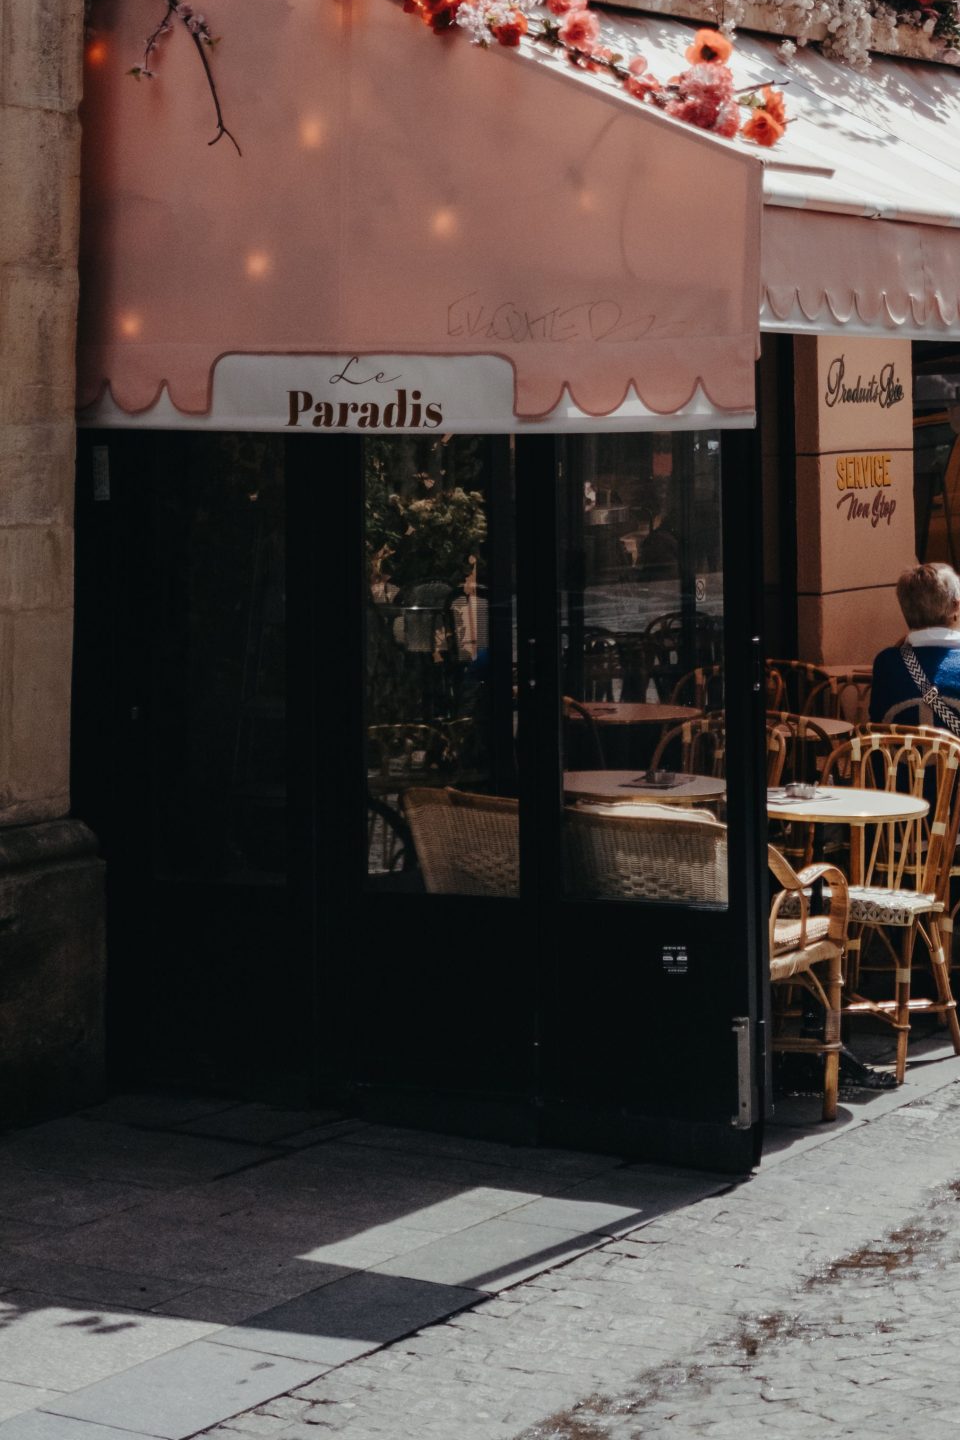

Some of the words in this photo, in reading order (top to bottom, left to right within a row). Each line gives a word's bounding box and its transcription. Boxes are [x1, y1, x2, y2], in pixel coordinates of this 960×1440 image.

[329, 356, 402, 385] Le
[825, 354, 880, 407] Produits
[878, 363, 904, 408] Bio
[284, 389, 443, 428] Paradis
[836, 454, 892, 491] SERVICE
[837, 492, 870, 521] Non
[871, 490, 896, 528] Stop
